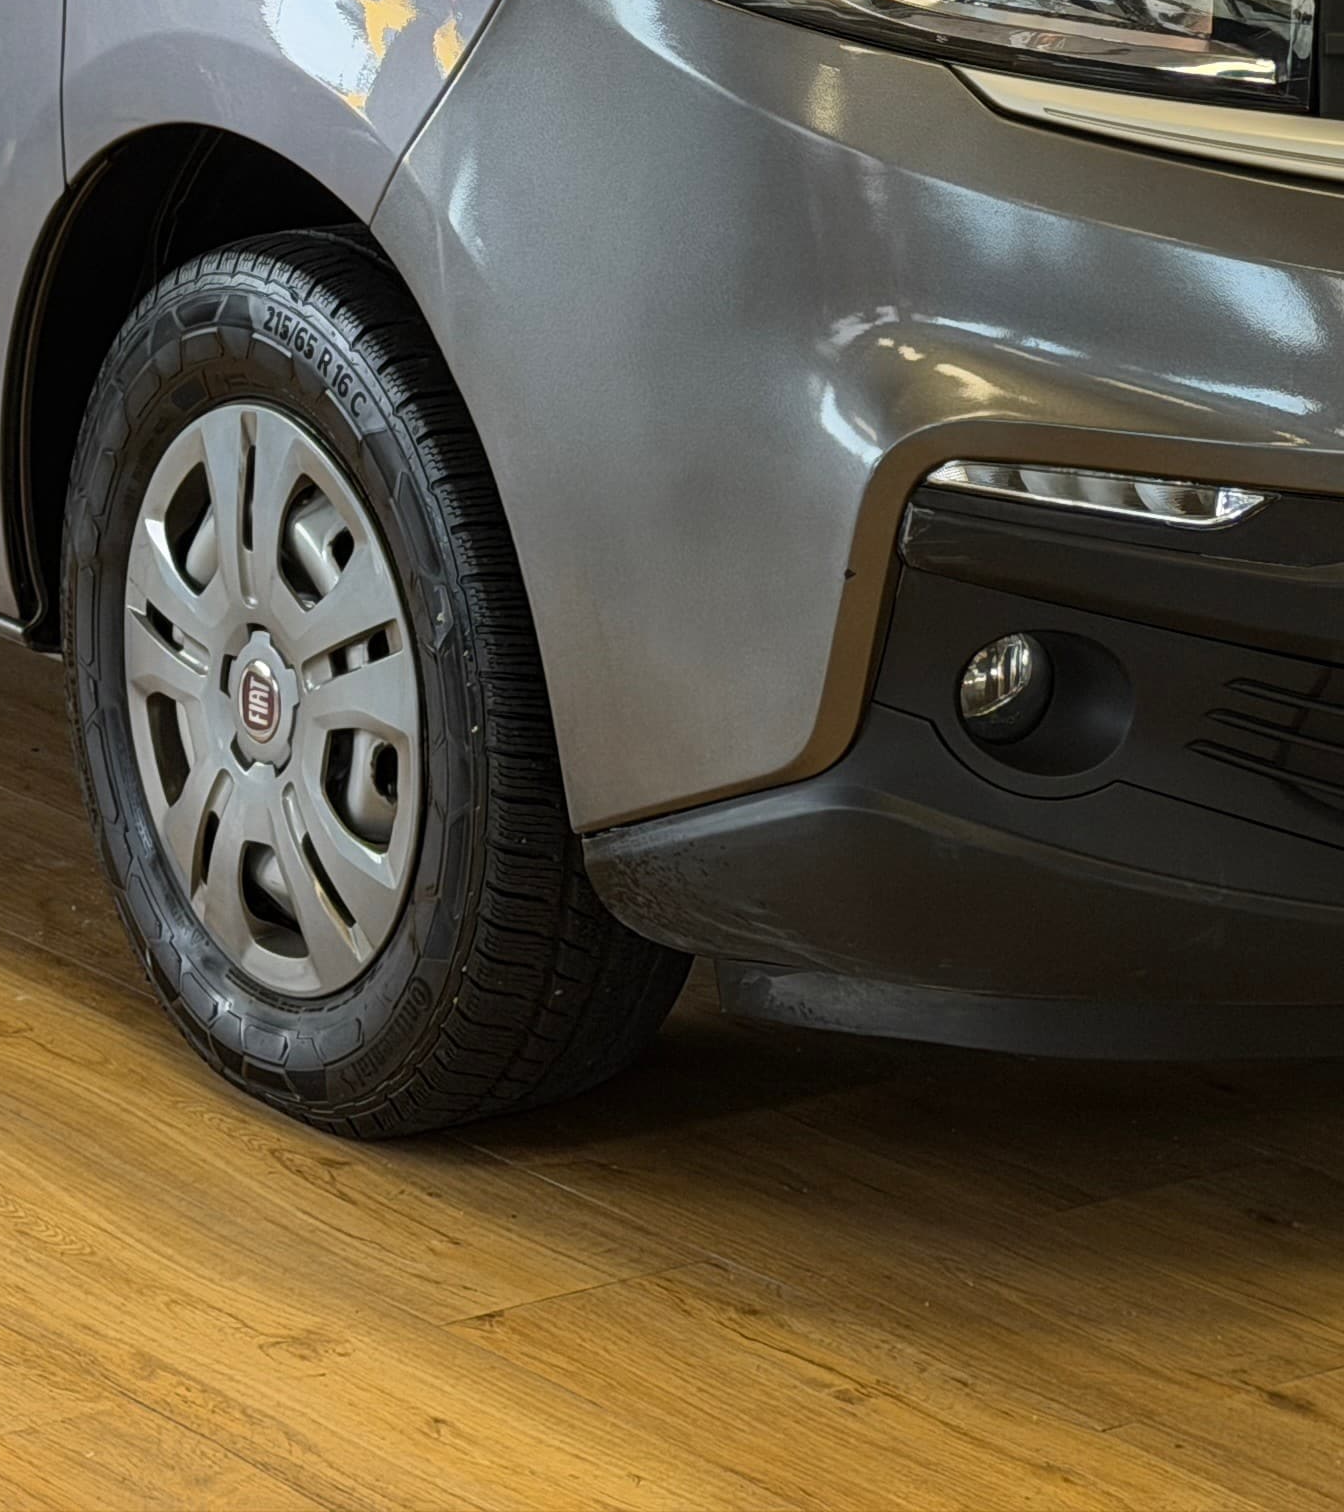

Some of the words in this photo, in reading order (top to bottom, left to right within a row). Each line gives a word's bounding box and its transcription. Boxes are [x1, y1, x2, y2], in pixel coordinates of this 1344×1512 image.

[263, 306, 318, 360] 215/65
[317, 348, 333, 377] R
[331, 363, 353, 398] 16
[350, 391, 367, 418] C
[248, 676, 270, 726] FIAT
